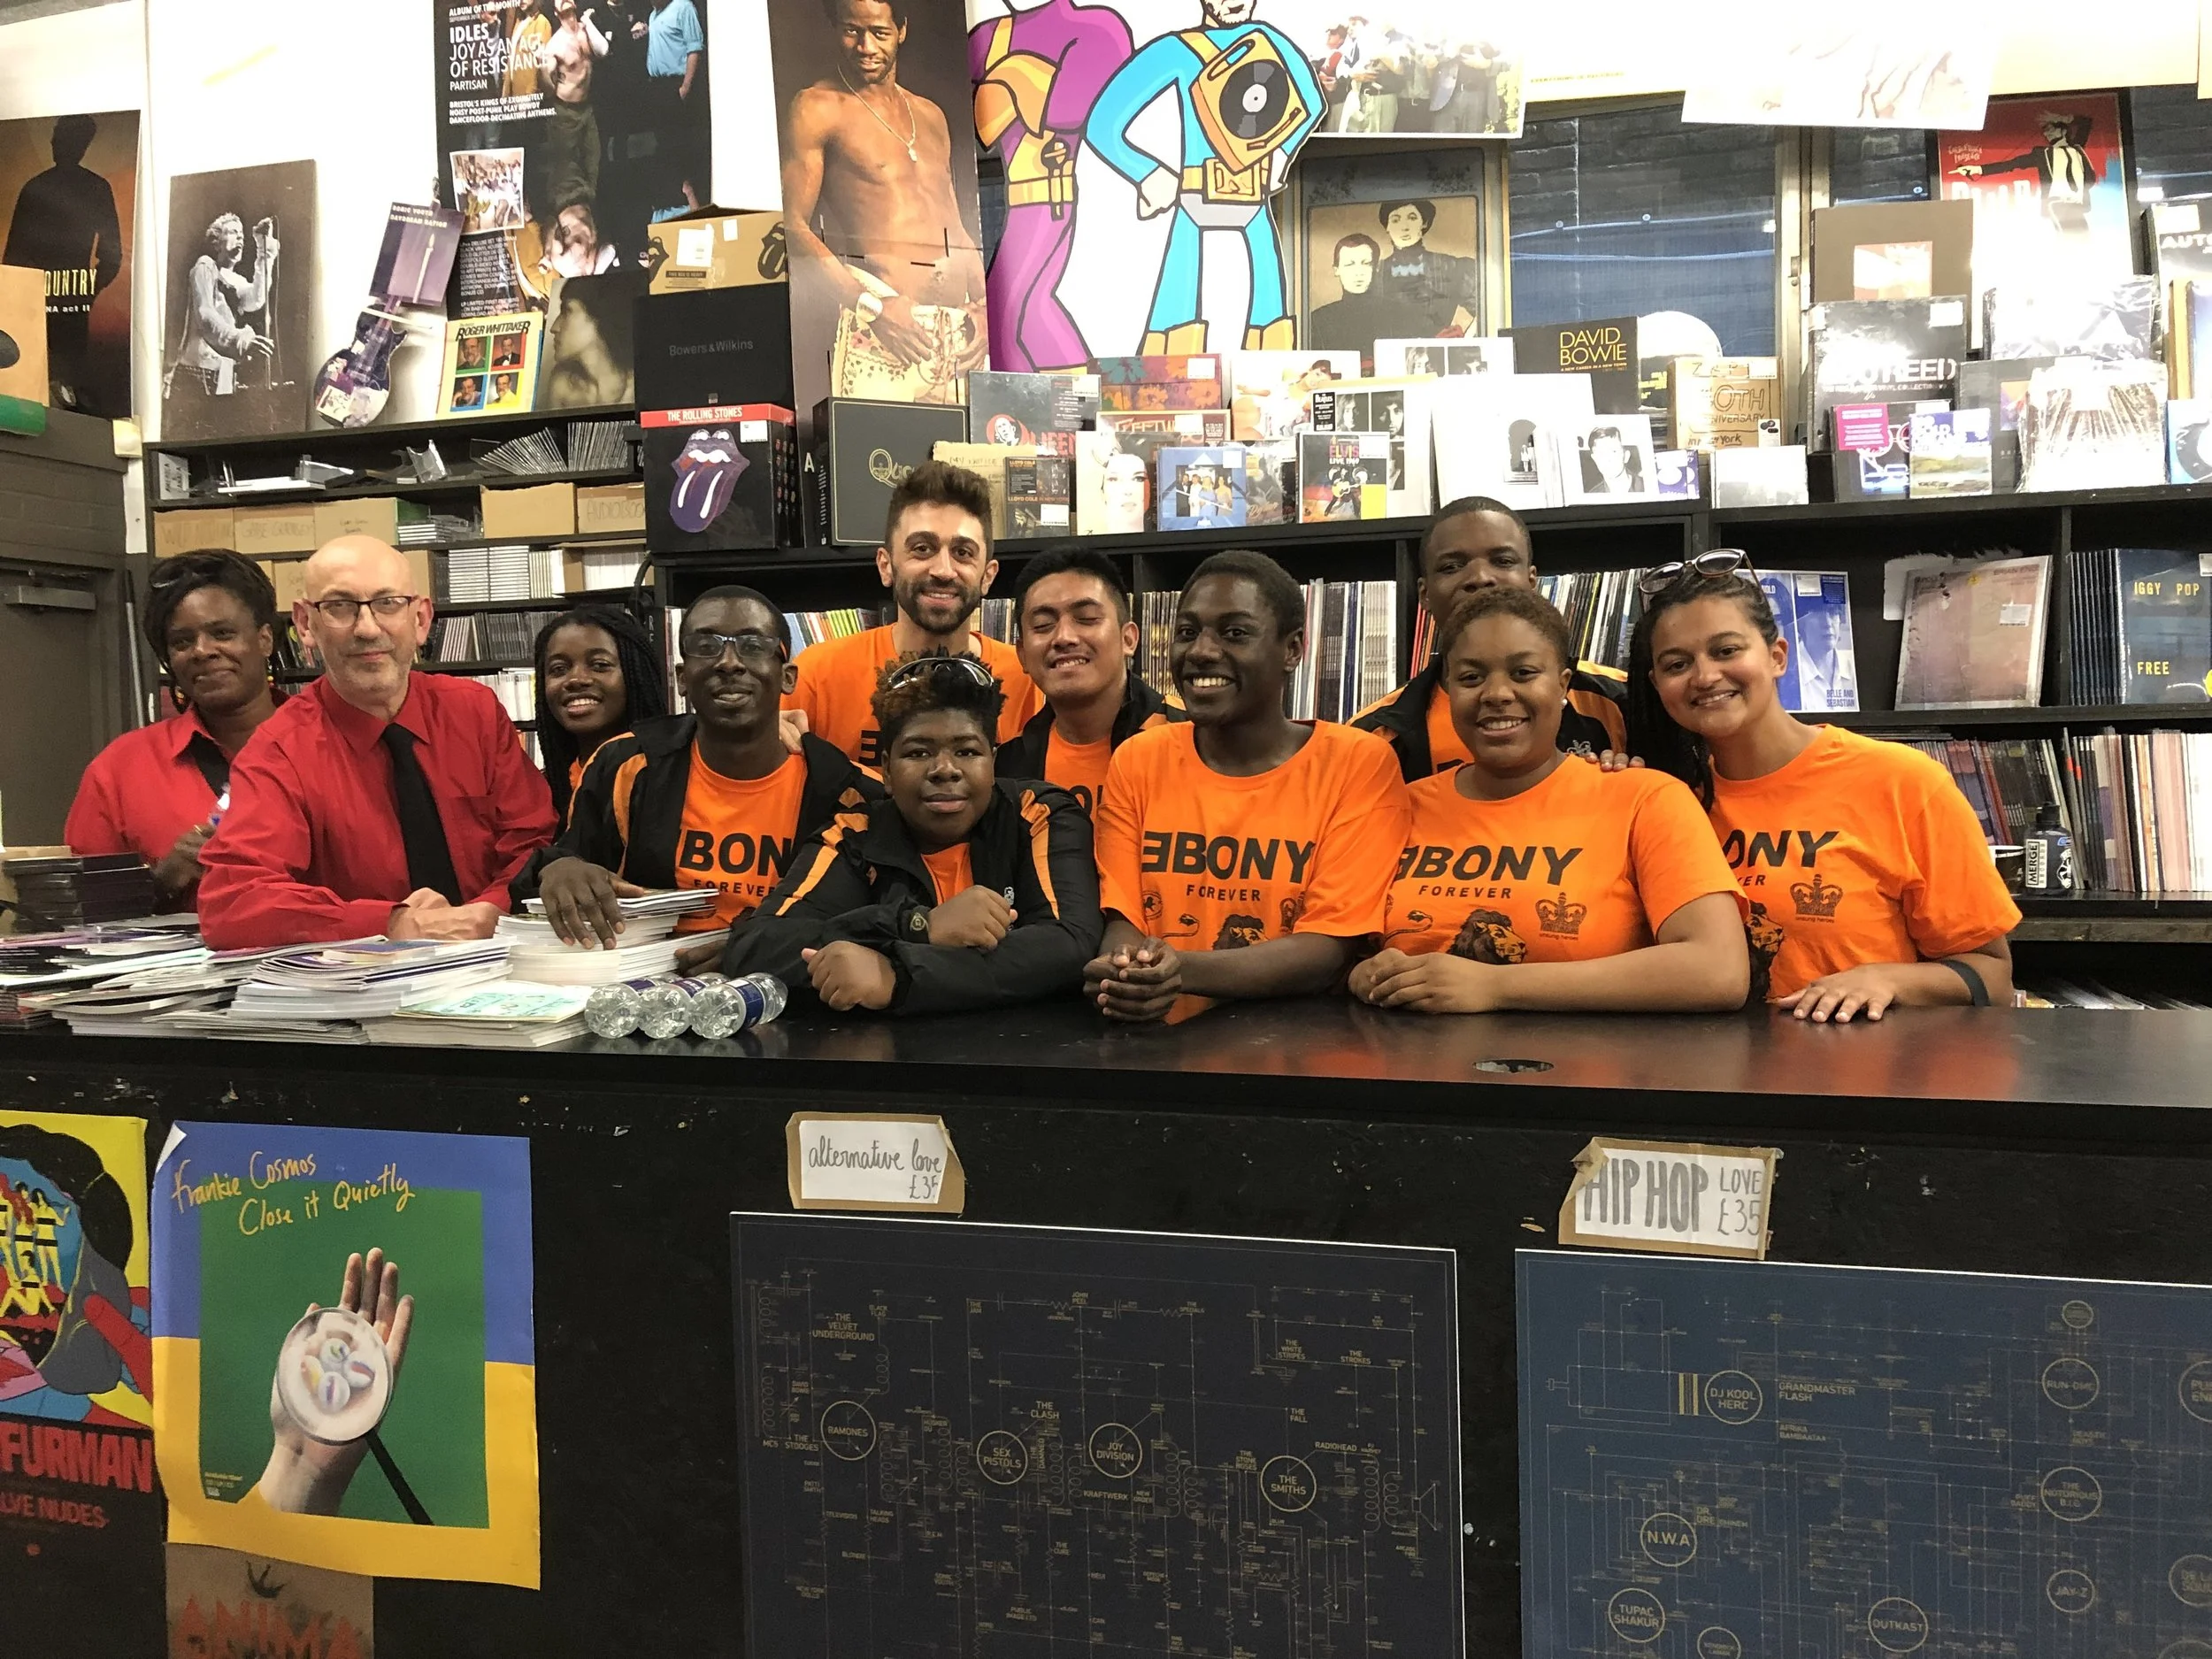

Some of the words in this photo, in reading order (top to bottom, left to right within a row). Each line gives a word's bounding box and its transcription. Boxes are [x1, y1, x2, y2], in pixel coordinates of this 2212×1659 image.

[449, 7, 472, 16] ALBUM
[449, 22, 488, 43] IDLES
[449, 42, 475, 60] JOY
[478, 41, 495, 58] AS
[497, 38, 513, 54] AN
[450, 61, 468, 78] OF
[472, 53, 549, 76] RESISTANCE
[449, 80, 488, 91] PARTISAN
[449, 99, 479, 108] BRISTOL'S
[45, 268, 97, 296] OUNTRY
[455, 325, 486, 342] ROGER
[486, 320, 531, 334] WHITTAKER
[1560, 327, 1621, 349] DAVID
[669, 344, 707, 357] Bowers
[1560, 343, 1627, 365] BOWIE
[667, 411, 680, 422] THE
[682, 409, 713, 420] ROLLING
[714, 407, 742, 419] STONES
[1711, 414, 1765, 424] NIVERSARY
[1329, 445, 1360, 458] ELVIS
[2134, 581, 2161, 595] IGGY
[2177, 583, 2200, 595] POP
[2137, 661, 2170, 675] FREE
[1826, 689, 1842, 698] BELLE
[1843, 689, 1855, 698] AND
[1826, 698, 1855, 708] SEBASTIAN
[679, 829, 793, 878] BON
[1722, 828, 1839, 870] ONY
[1141, 831, 1316, 884] EBONY
[2028, 844, 2038, 883] MERGE
[1186, 884, 1261, 902] FOREVER
[1418, 885, 1512, 899] FOREVER
[809, 1135, 904, 1171] alternative
[911, 1138, 942, 1173] love
[250, 1151, 317, 1190] Cosmos
[1719, 1166, 1763, 1195] LOVE
[239, 1198, 294, 1235] Close
[303, 1190, 319, 1219] it
[334, 1163, 416, 1212] Quietly
[1584, 1158, 1640, 1225] HIP
[1645, 1160, 1709, 1233] HOP
[834, 1313, 851, 1322] THE
[828, 1322, 858, 1331] VELVET
[812, 1330, 875, 1341] UNDERGROUND
[1710, 1387, 1724, 1397] DJ
[1726, 1389, 1757, 1401] KOOL
[1778, 1382, 1856, 1395] GRANDMASTER
[1778, 1391, 1813, 1402] FLASH
[1036, 1401, 1054, 1410] THE
[1718, 1400, 1749, 1410] HERC
[1030, 1409, 1060, 1419] CLASH
[827, 1425, 868, 1438] RAMONES
[993, 1448, 1010, 1457] SEX
[1107, 1442, 1124, 1452] JOY
[1315, 1441, 1357, 1452] RADIOHEAD
[0, 1421, 153, 1493] FURMAN
[983, 1457, 1022, 1469] PISTOLS
[1096, 1450, 1134, 1462] DIVISION
[1279, 1475, 1297, 1485] THE
[1083, 1490, 1128, 1501] KRAFTWERK
[1271, 1483, 1307, 1495] SMITHS
[1618, 1603, 1655, 1617] TUPAC
[1614, 1614, 1660, 1628] SHAKUR
[1872, 1618, 1924, 1633] OUTKAST
